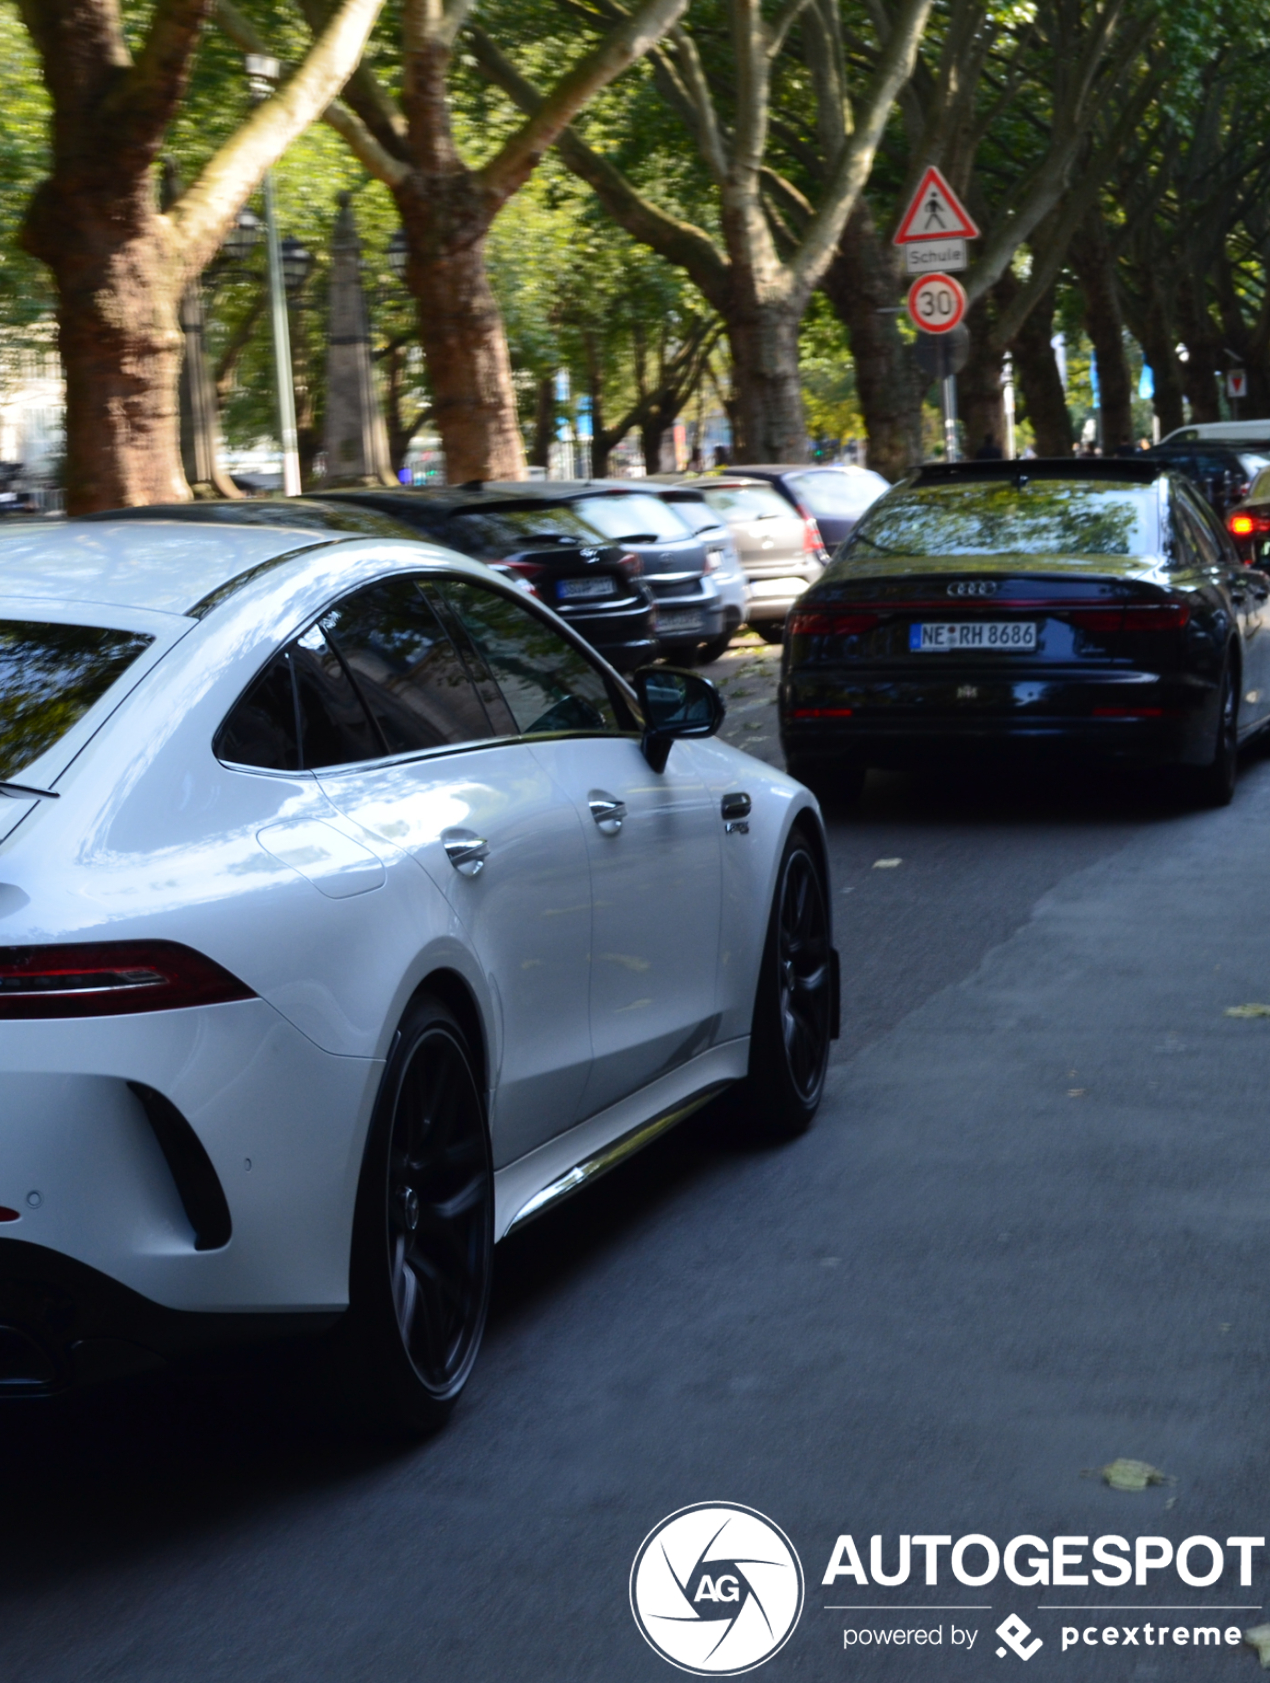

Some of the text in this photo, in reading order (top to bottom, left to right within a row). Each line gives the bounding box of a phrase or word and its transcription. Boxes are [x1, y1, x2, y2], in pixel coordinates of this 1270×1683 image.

[910, 249, 961, 265] Schule
[920, 291, 952, 317] 30
[922, 625, 1033, 645] NE RH 8686
